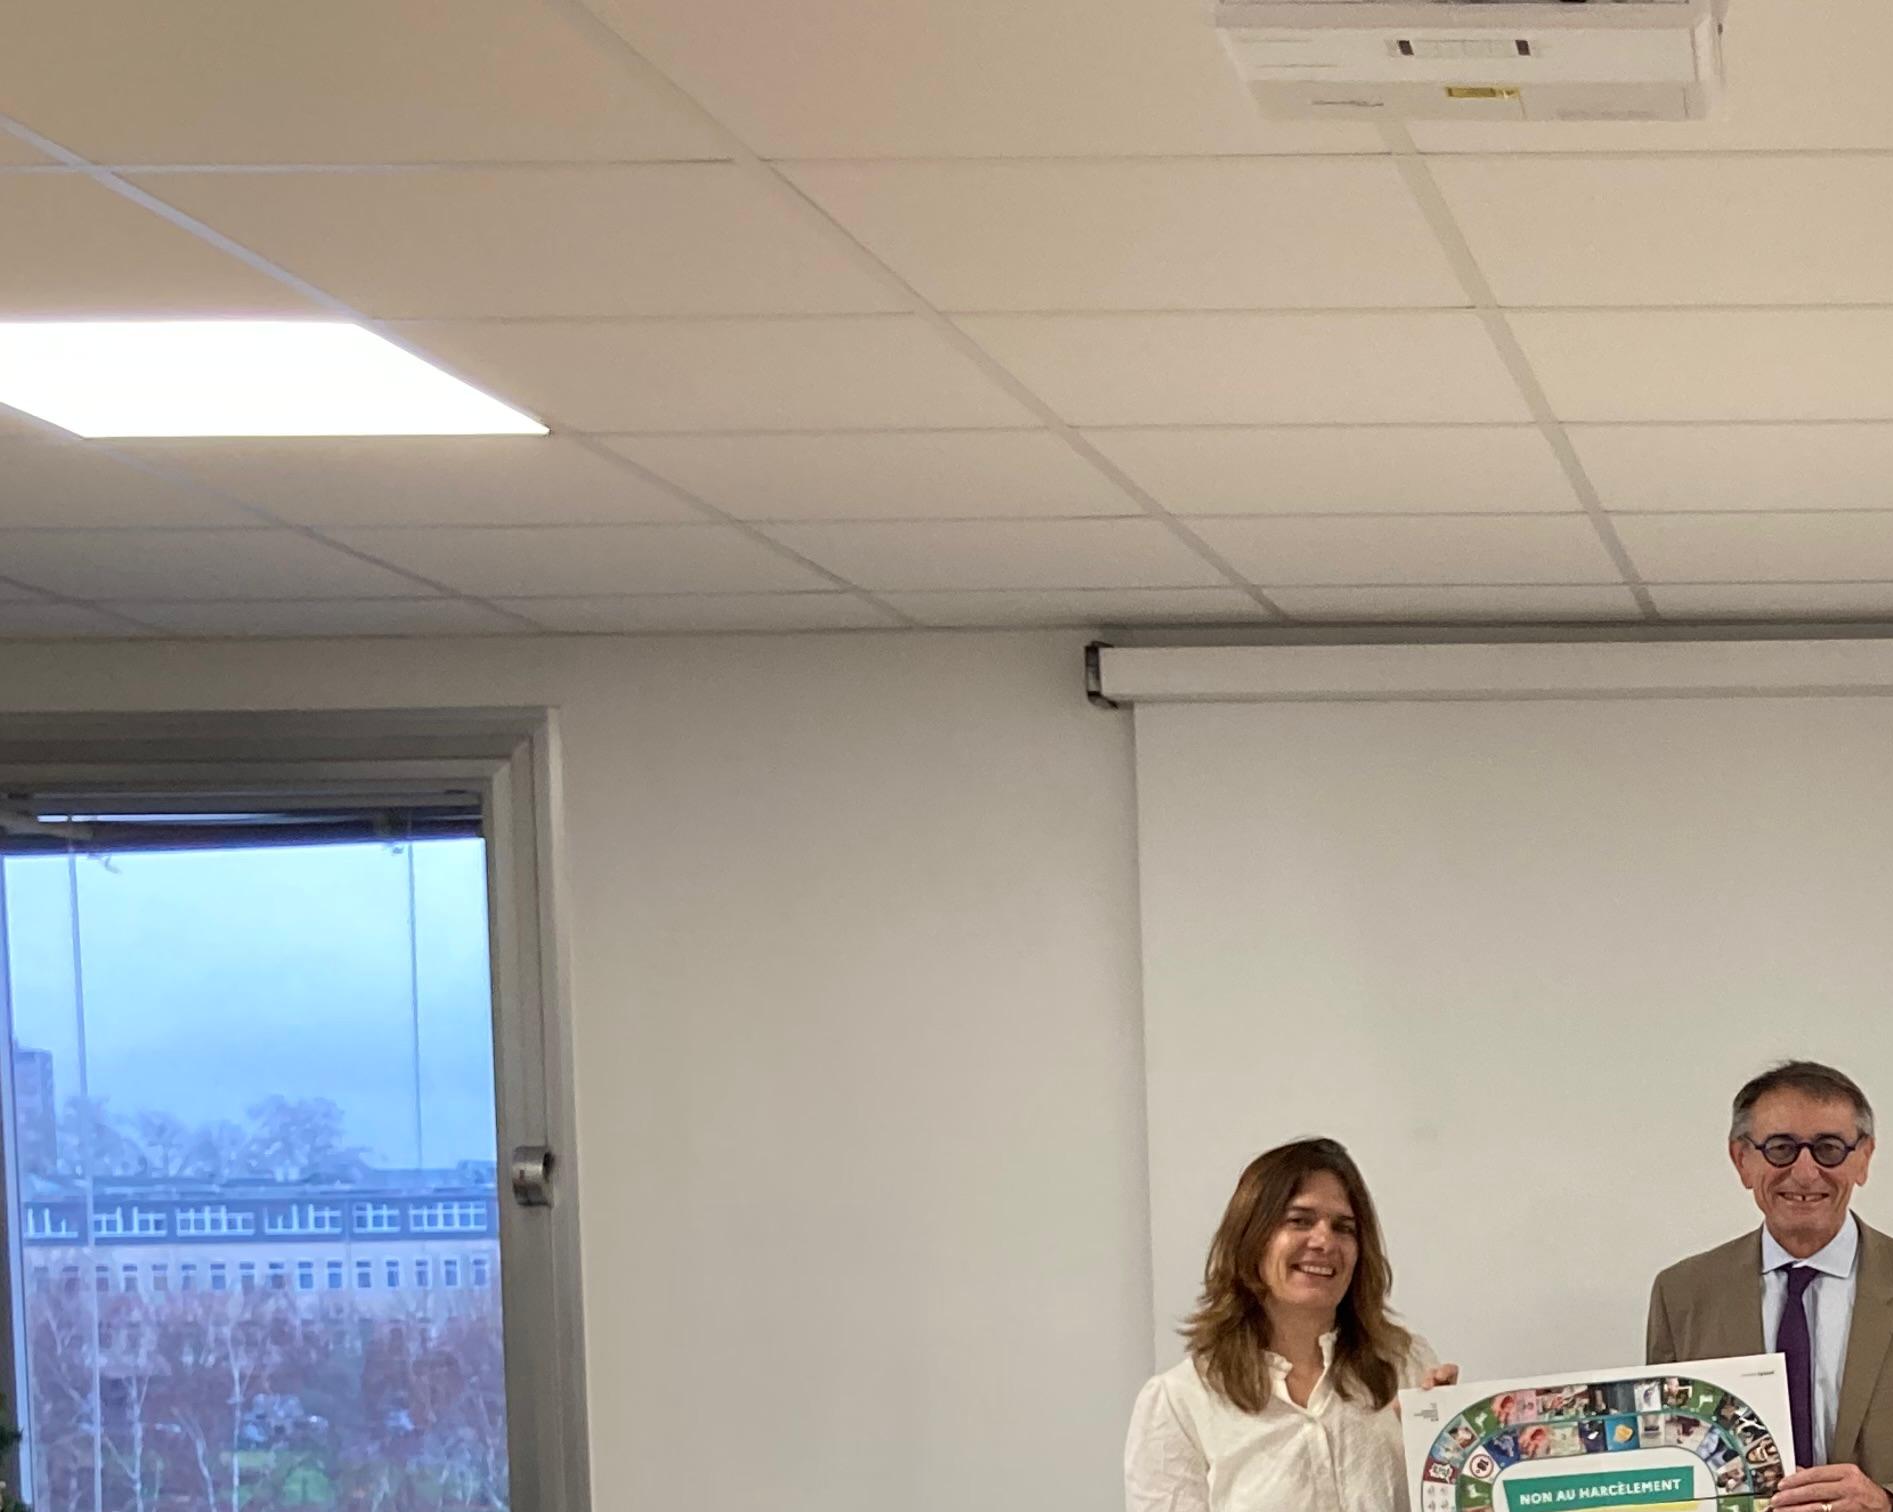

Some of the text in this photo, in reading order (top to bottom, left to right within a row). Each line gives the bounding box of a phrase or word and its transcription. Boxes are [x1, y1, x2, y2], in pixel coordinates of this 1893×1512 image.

[1519, 1478, 1682, 1505] NON AU HARCÈLEMENT
